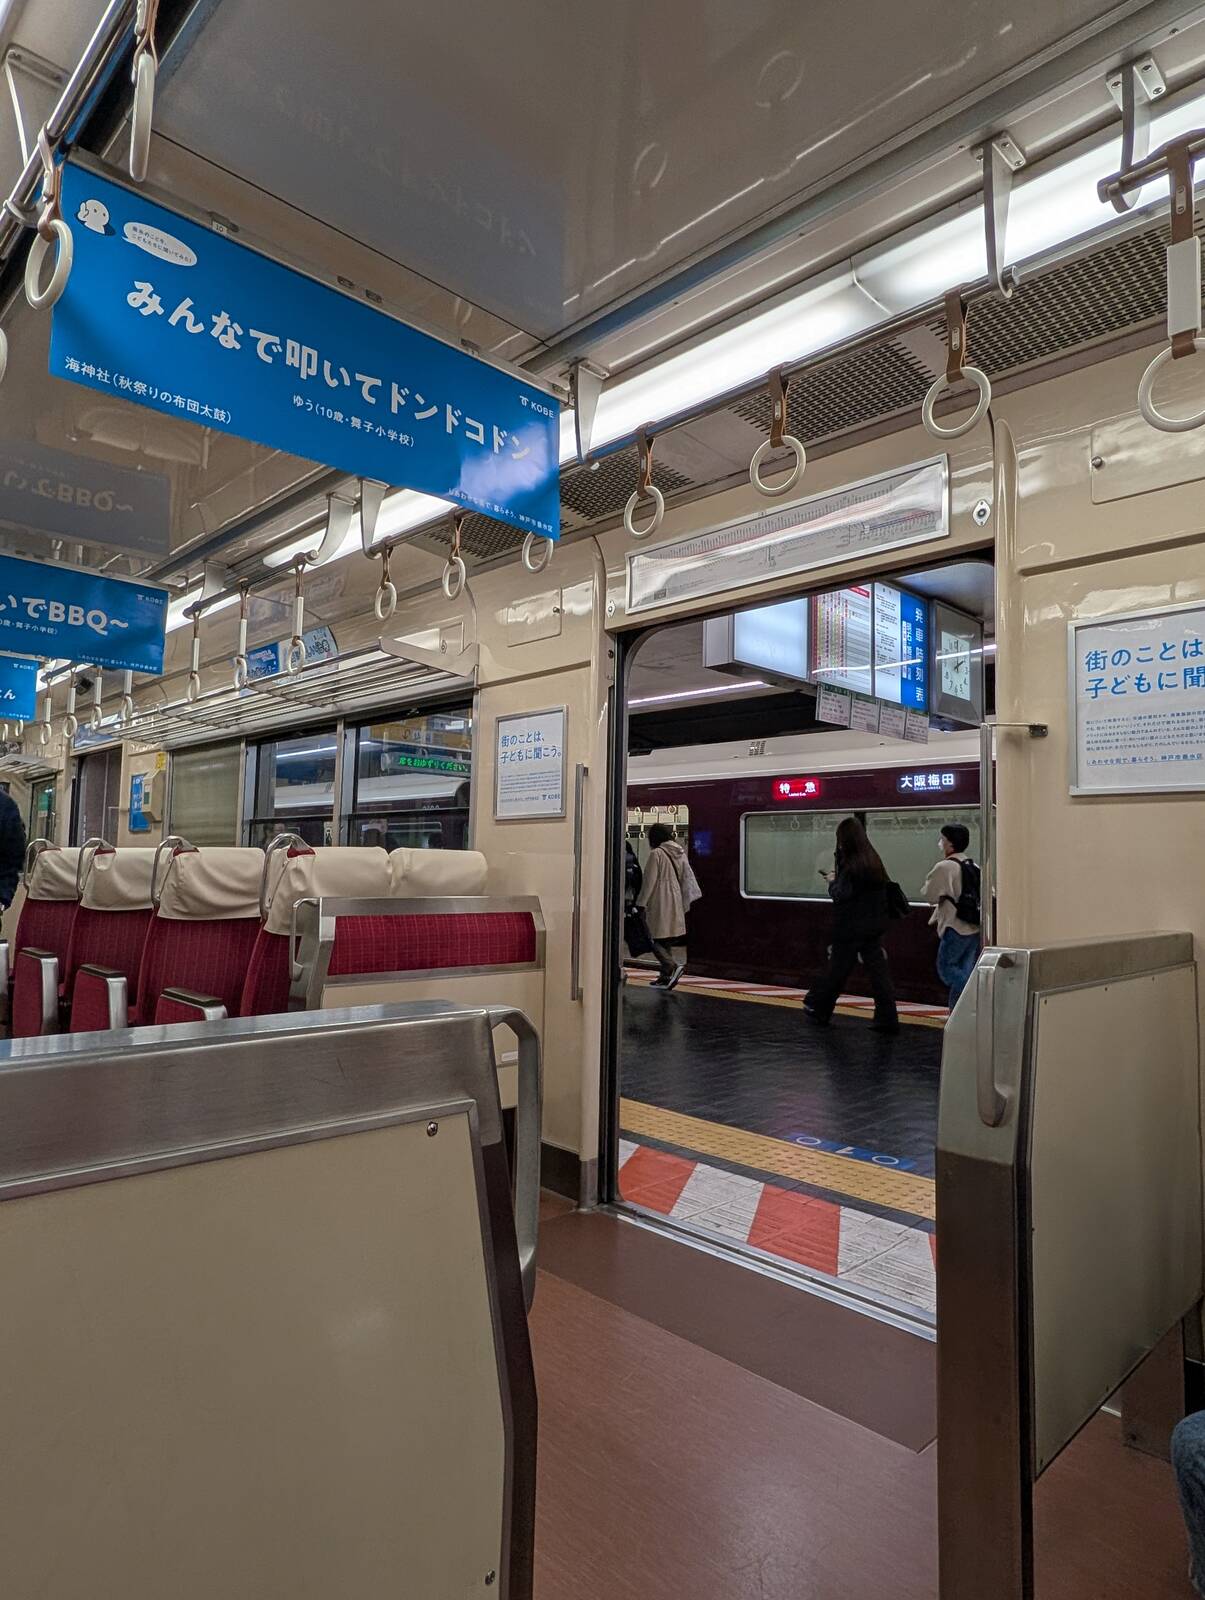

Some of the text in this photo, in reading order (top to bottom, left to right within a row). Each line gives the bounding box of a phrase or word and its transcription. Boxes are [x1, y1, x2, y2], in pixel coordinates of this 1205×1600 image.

[127, 281, 530, 460] みんなで叩いてドンドコドン
[64, 356, 233, 425] 海神社（秋祭りの布団太鼓）
[293, 395, 415, 448] ゆう（10歳・舞子小学校）
[530, 401, 555, 419] KOBE
[1085, 638, 1203, 672] 街のことは
[1085, 666, 1205, 699] 子どもに聞
[501, 731, 545, 748] 街のことは、
[500, 746, 562, 764] 子どもに聞こう。
[779, 781, 816, 795] 特急
[900, 773, 954, 788] 大阪梅田
